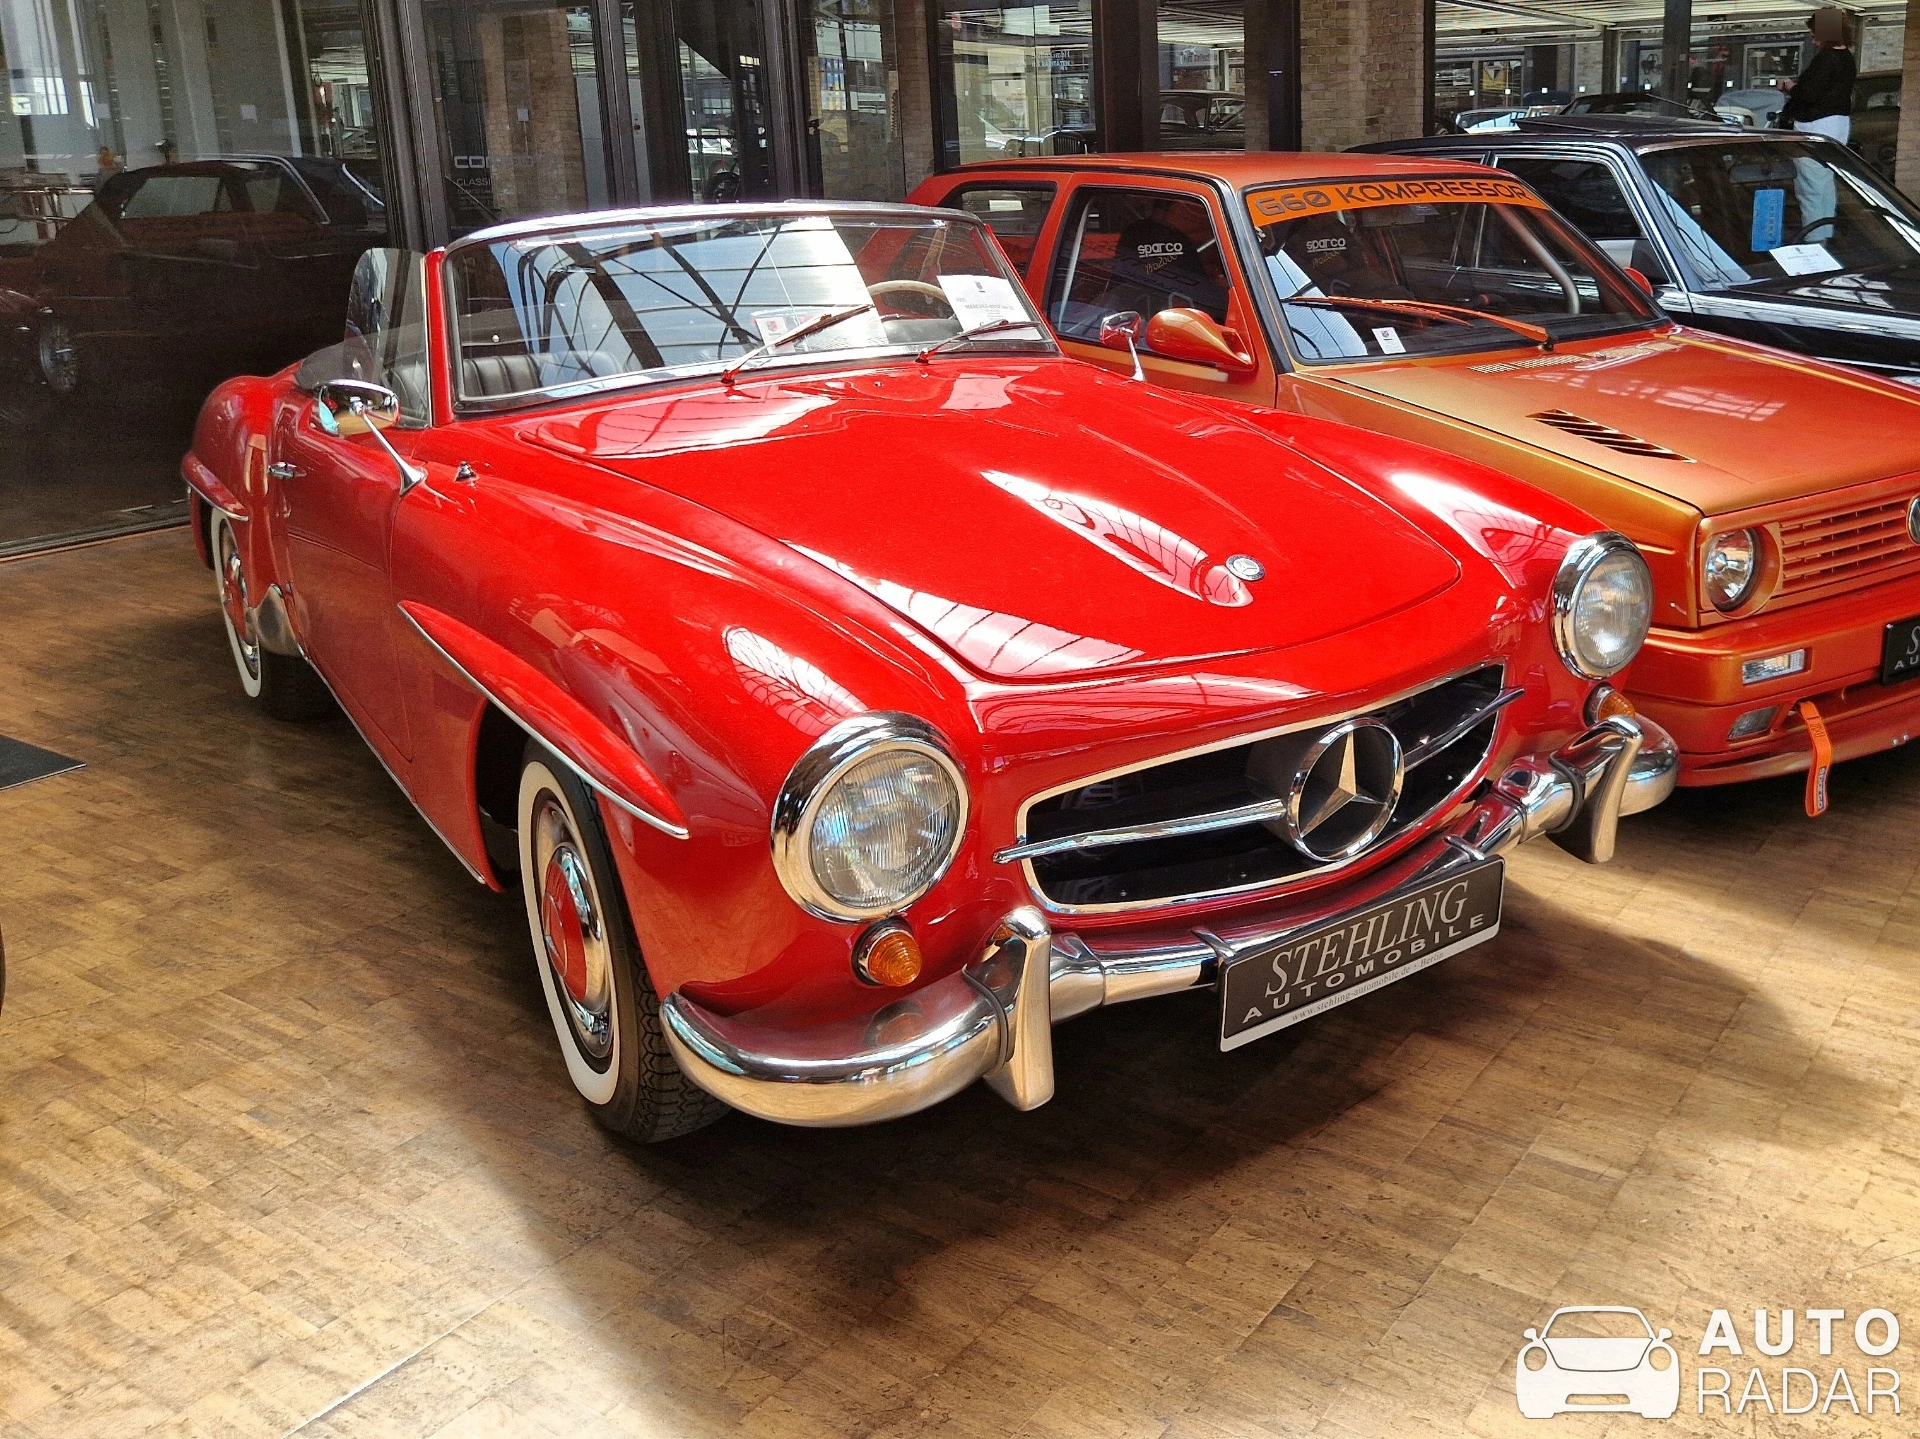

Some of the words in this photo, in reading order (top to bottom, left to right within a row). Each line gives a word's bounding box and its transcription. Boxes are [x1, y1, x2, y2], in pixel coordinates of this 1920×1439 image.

[1255, 189, 1332, 217] G60
[1335, 181, 1535, 205] KOMPRESSOR
[1137, 242, 1184, 258] sparco
[1306, 237, 1347, 253] sparco
[1906, 625, 1920, 655] S
[1893, 654, 1920, 670] AU
[1264, 879, 1470, 999] STEHLING
[1242, 913, 1485, 1024] AUTOMOBILE
[1291, 966, 1411, 1022] www.stehling-automobile.de
[1420, 951, 1444, 967] Berlin
